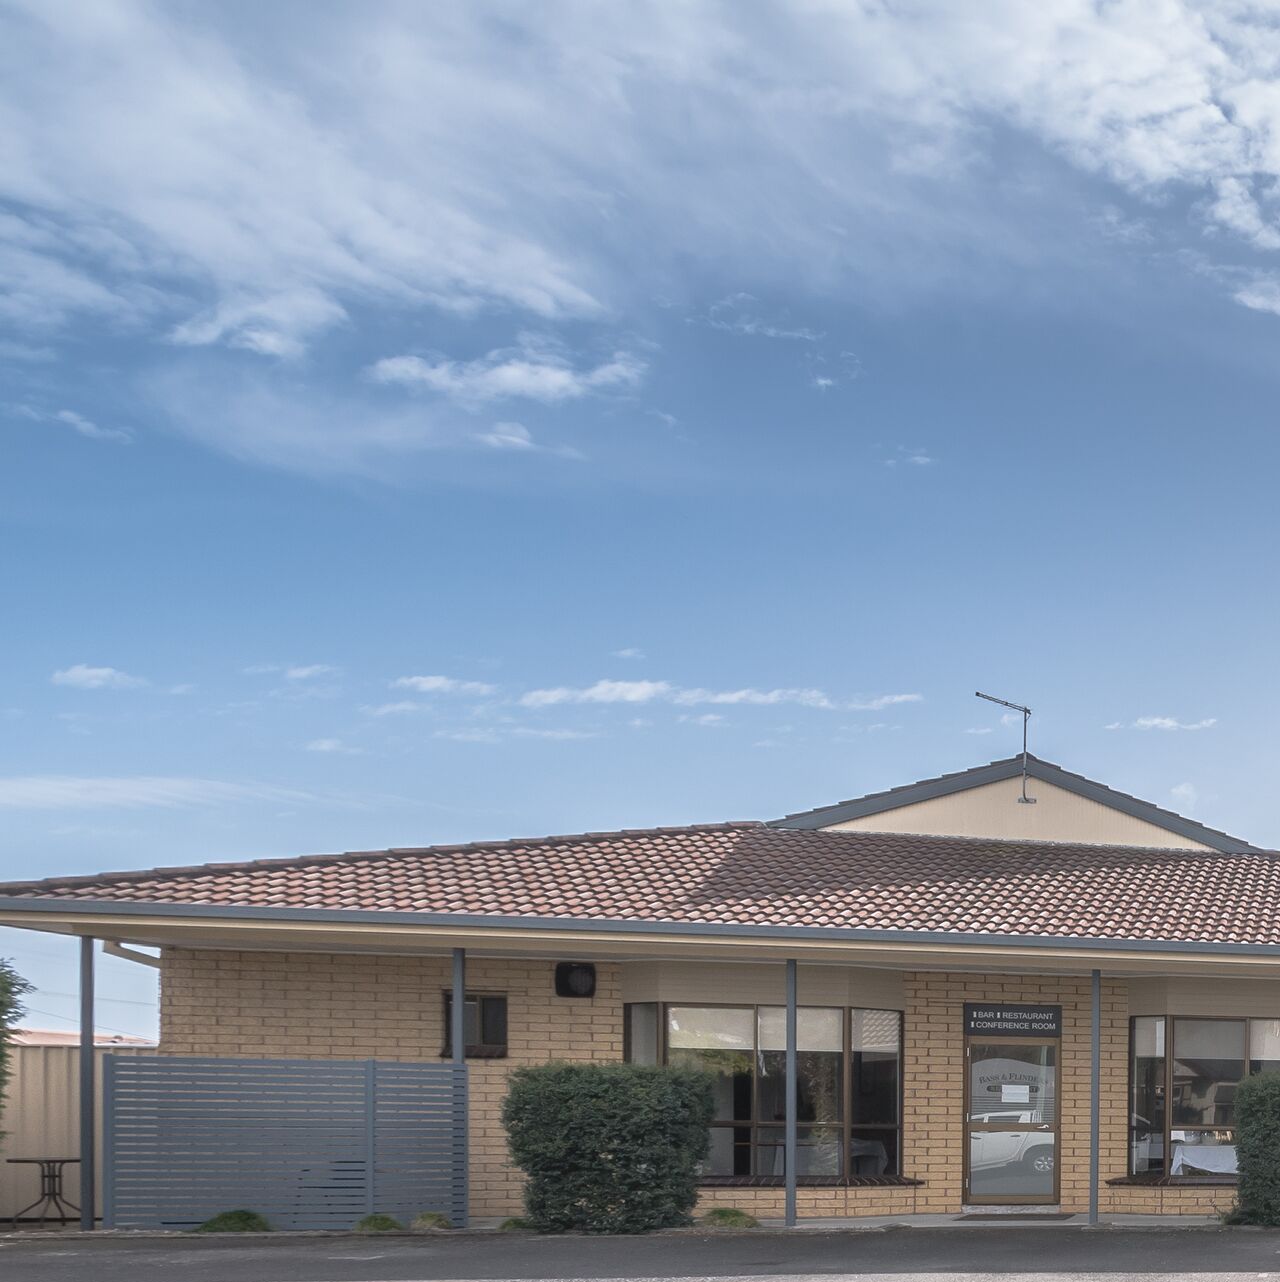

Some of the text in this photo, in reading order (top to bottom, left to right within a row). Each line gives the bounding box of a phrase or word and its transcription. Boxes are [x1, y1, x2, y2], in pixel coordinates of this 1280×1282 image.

[978, 1011, 1054, 1020] BAR RESTAURANT
[976, 1021, 1056, 1030] CONFERENCE ROOM
